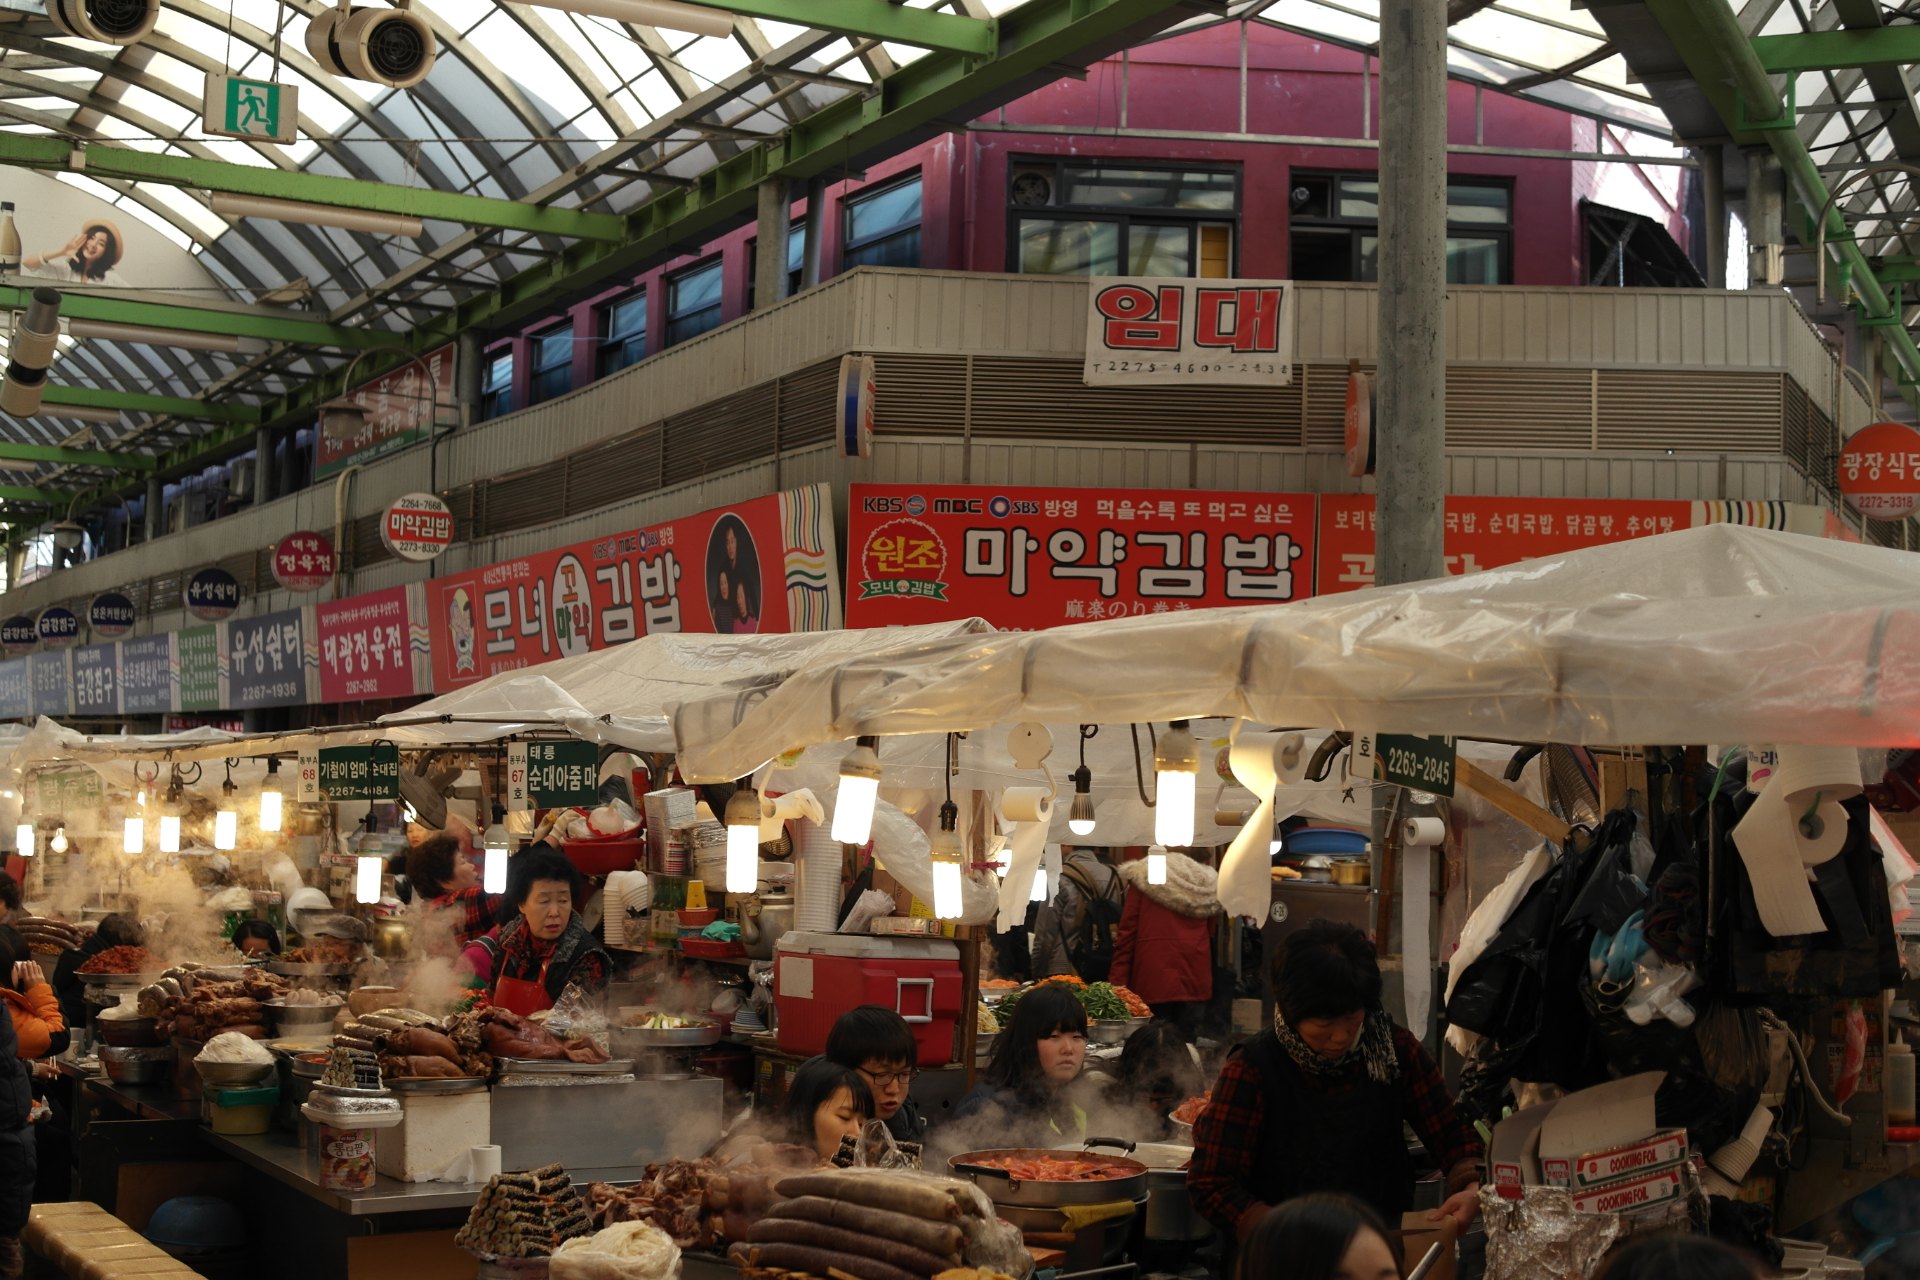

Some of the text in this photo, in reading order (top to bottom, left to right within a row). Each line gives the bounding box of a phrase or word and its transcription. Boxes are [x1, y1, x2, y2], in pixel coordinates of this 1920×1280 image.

[1095, 284, 1284, 353] 임대
[1842, 452, 1920, 481] 광장식당
[401, 498, 442, 511] 2264-7668
[864, 497, 903, 513] KBS
[1012, 501, 1039, 514] SBS
[1044, 499, 1078, 518] 방영
[1096, 499, 1293, 524] 먹을수록 또 먹고 싶은
[1859, 496, 1913, 508] 2272-3318
[391, 513, 450, 539] 마약김밥
[1626, 516, 1675, 534] 추어탕
[291, 538, 319, 552] 대광
[399, 541, 440, 553] 2273-8330
[592, 544, 609, 560] KBS
[659, 526, 674, 546] 방영
[279, 554, 331, 572] 정육점
[869, 536, 942, 572] 원조
[964, 526, 1302, 600] 마약김밥
[190, 581, 236, 601] 유성쉼터
[561, 564, 578, 604] 꼬
[869, 580, 894, 594] 모녀
[911, 581, 936, 595] 김밥
[483, 549, 681, 656] 모녀 김밥
[556, 601, 590, 649] 마약
[231, 619, 302, 677] 유성쉼터
[323, 623, 404, 676] 대광정육점
[77, 667, 113, 705] 금강침구
[242, 682, 297, 701] 2267-1936
[530, 745, 555, 760] 태릉
[1360, 736, 1370, 757] 호
[321, 761, 398, 779] 기철이 엄마 순대집
[510, 755, 526, 765] 동부A
[1388, 747, 1450, 786] 2263-2845
[303, 769, 316, 780] 68
[512, 770, 524, 783] 67
[528, 763, 597, 792] 순대아줌마
[304, 783, 314, 793] 호
[514, 787, 522, 800] 호
[1610, 1153, 1642, 1172] COOKING
[1643, 1149, 1658, 1165] FOIL
[1597, 1191, 1632, 1212] COOKING
[1633, 1187, 1649, 1204] FOIL
